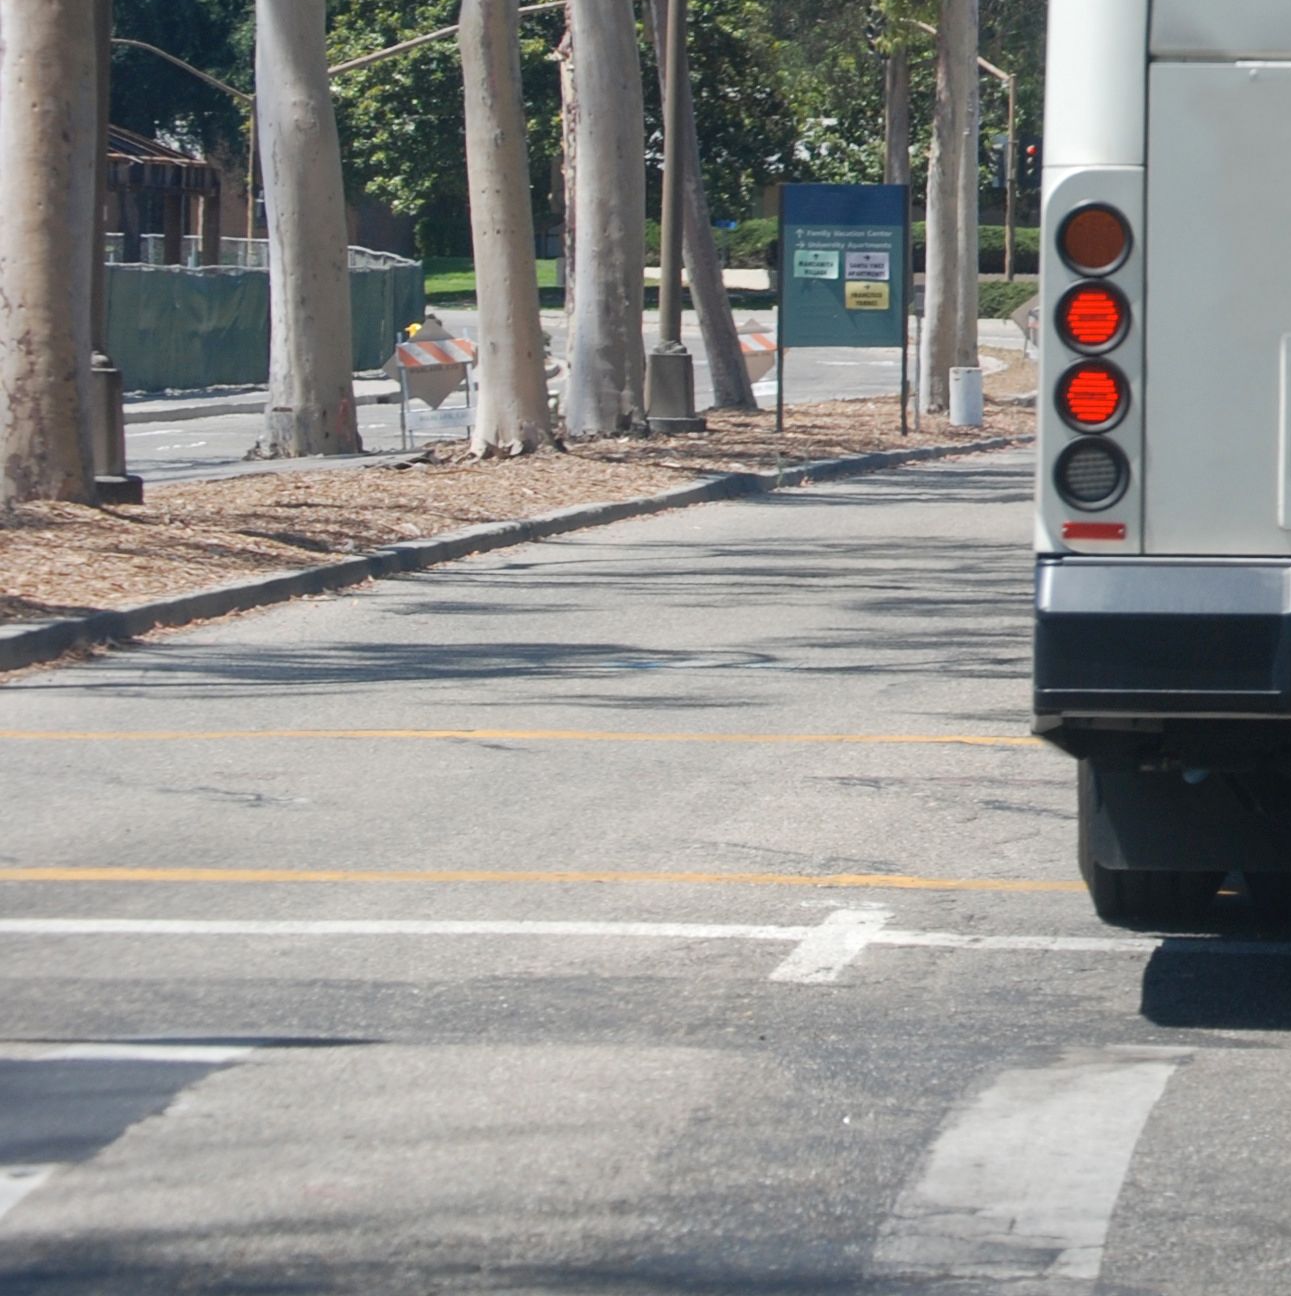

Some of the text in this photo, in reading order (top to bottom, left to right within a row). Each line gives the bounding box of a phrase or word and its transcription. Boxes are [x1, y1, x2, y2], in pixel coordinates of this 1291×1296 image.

[806, 230, 831, 238] Family
[807, 241, 892, 249] University Apartments
